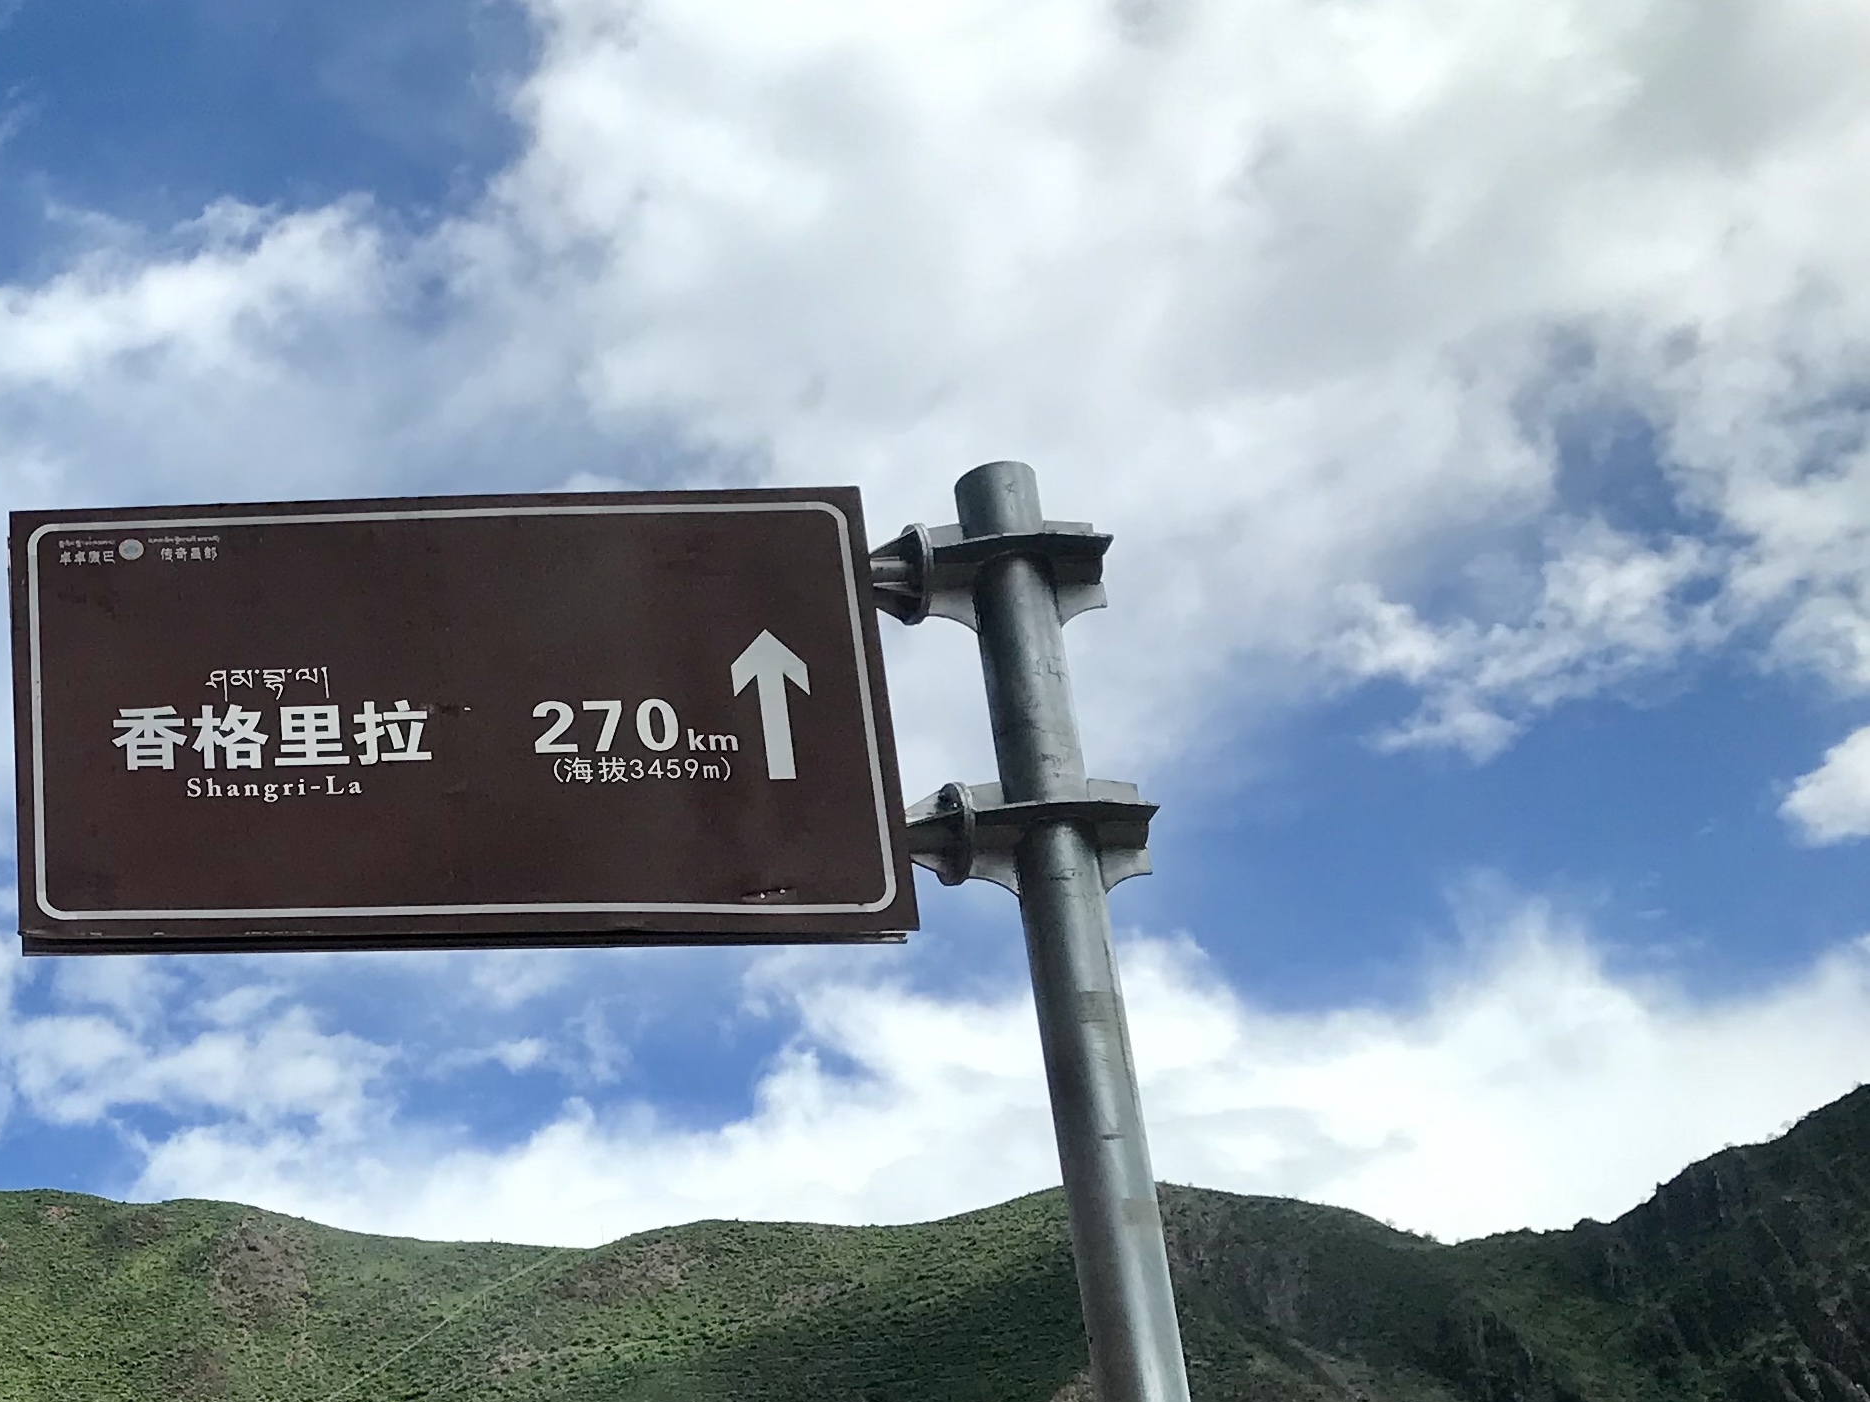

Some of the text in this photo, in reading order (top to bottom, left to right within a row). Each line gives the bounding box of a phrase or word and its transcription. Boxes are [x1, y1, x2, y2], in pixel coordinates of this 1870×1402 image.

[111, 699, 433, 771] 香格里拉
[532, 698, 739, 754] 270 km
[186, 774, 363, 803] Shangri-La
